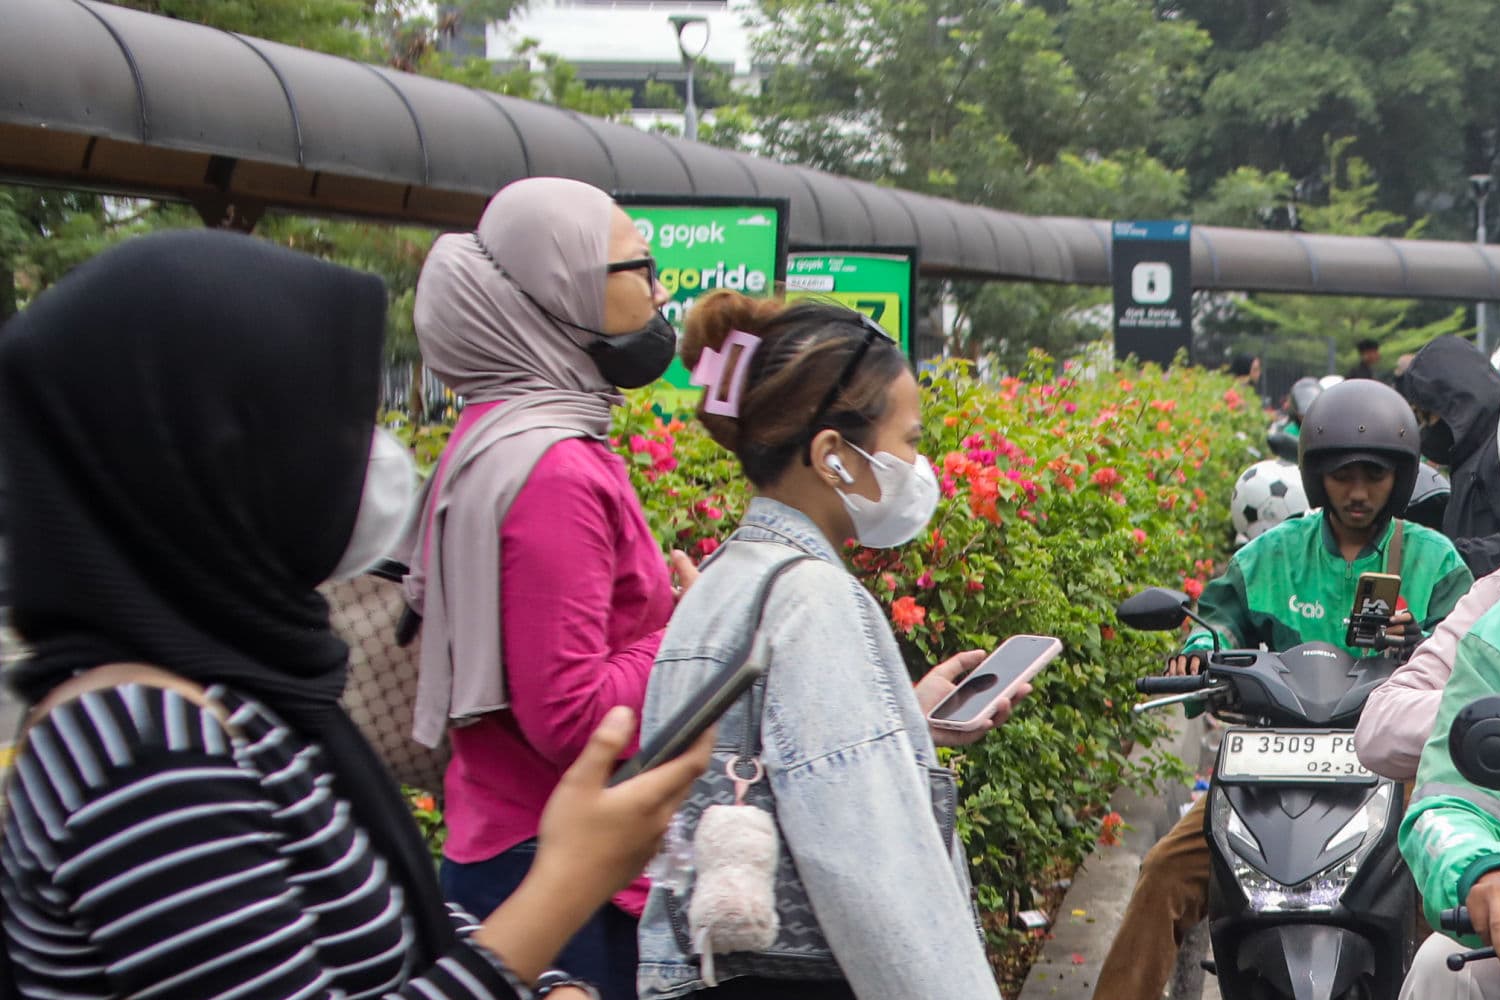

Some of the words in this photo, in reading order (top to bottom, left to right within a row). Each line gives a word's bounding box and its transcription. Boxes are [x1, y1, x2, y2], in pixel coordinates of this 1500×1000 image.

[659, 221, 725, 248] gojek
[659, 261, 766, 295] goride
[1289, 594, 1326, 619] Grab
[1230, 735, 1244, 754] B
[1258, 735, 1316, 755] 3509
